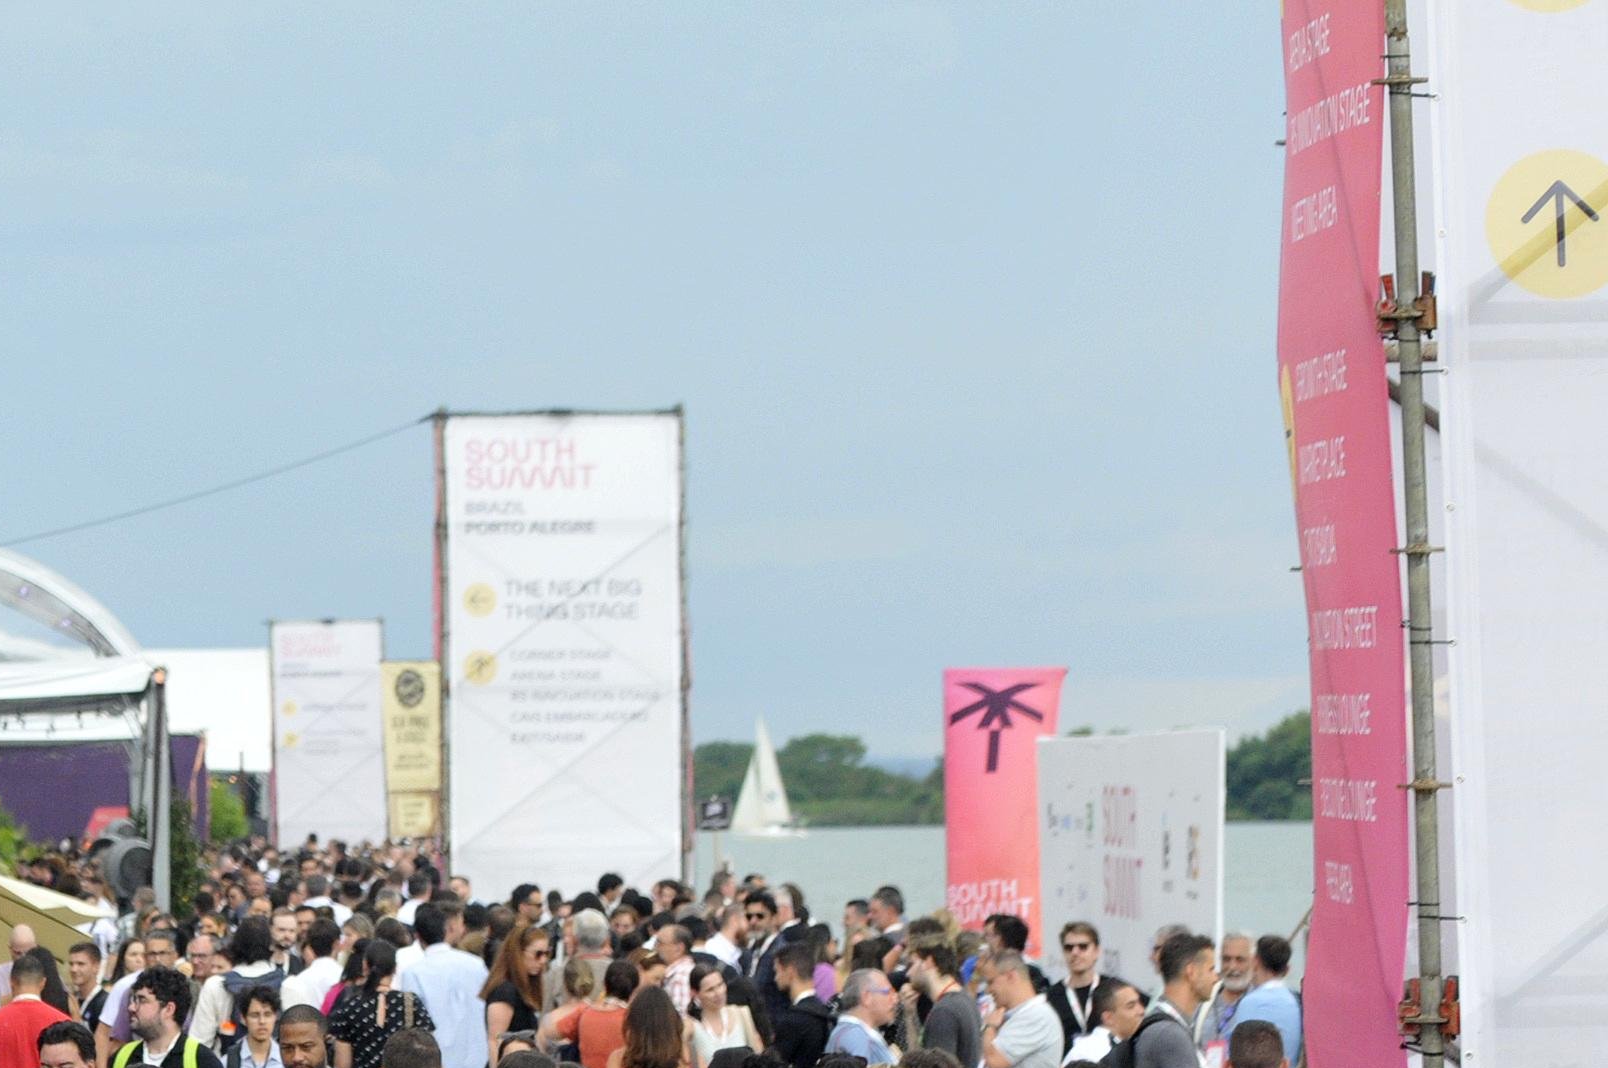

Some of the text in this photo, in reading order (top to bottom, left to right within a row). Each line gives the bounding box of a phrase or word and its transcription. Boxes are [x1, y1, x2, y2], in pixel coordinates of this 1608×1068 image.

[1338, 79, 1371, 132] STAGE
[465, 438, 577, 465] SOUTH
[465, 464, 597, 490] SUMMIT
[464, 520, 595, 535] PORTO ALEGRE
[505, 578, 643, 597] THE NEXT BIG
[505, 602, 640, 620] THING STAGE
[948, 879, 1018, 906] SOUTH
